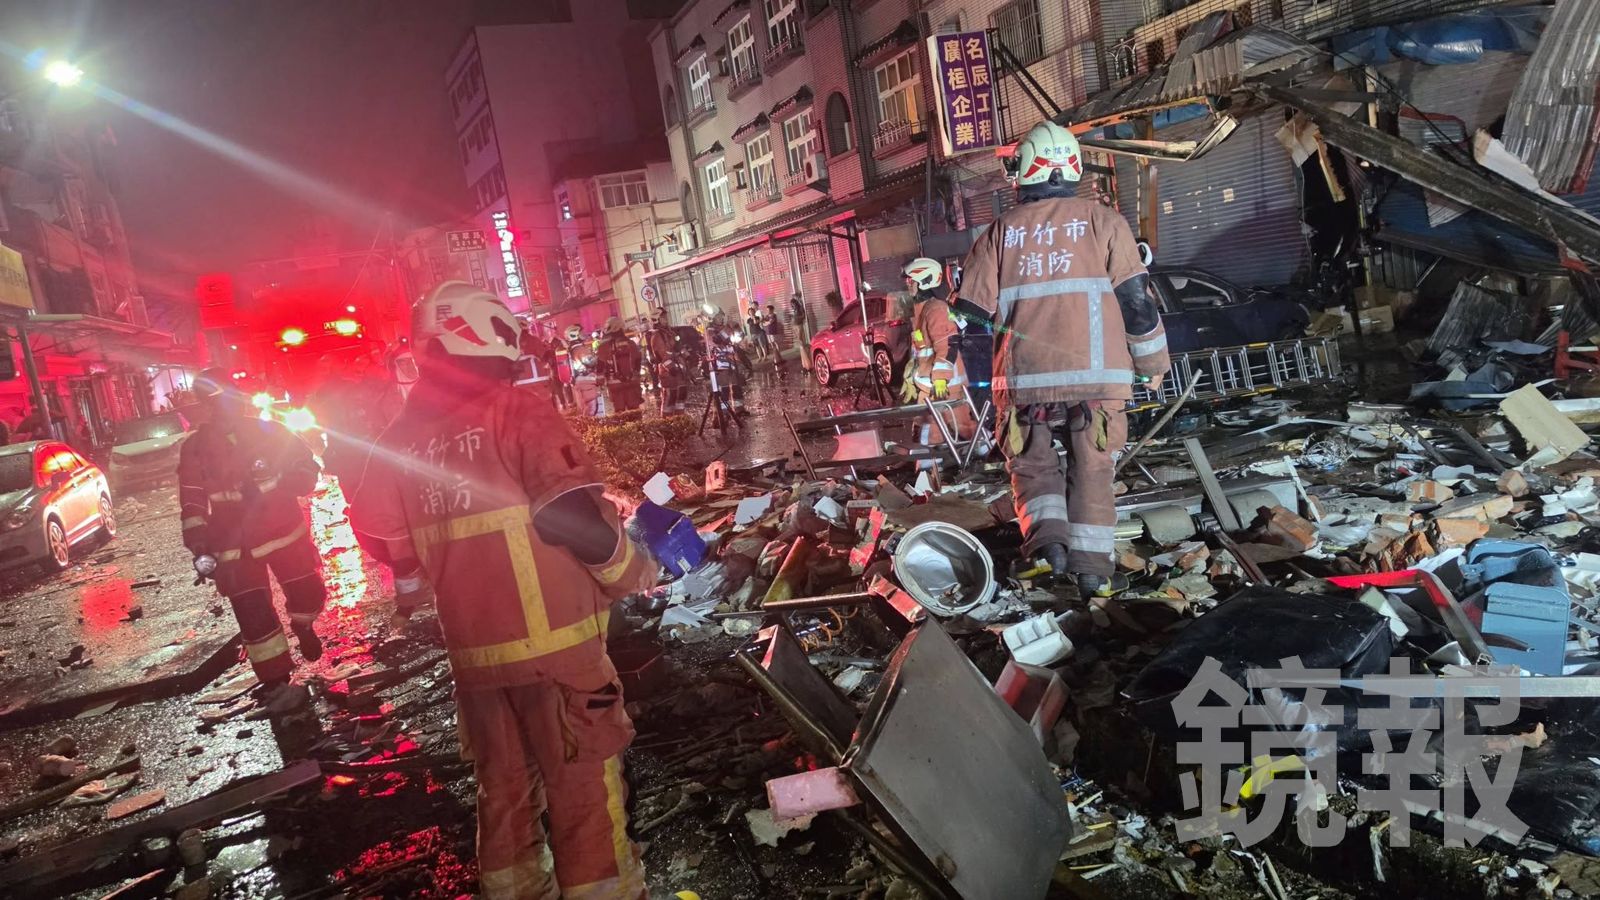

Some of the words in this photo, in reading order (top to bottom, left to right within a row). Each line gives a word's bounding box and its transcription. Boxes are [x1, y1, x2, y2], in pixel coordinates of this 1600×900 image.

[942, 39, 975, 146] 廣桓企業
[966, 37, 993, 142] 名辰工程
[1004, 218, 1089, 249] 新竹市
[1018, 248, 1074, 277] 消防
